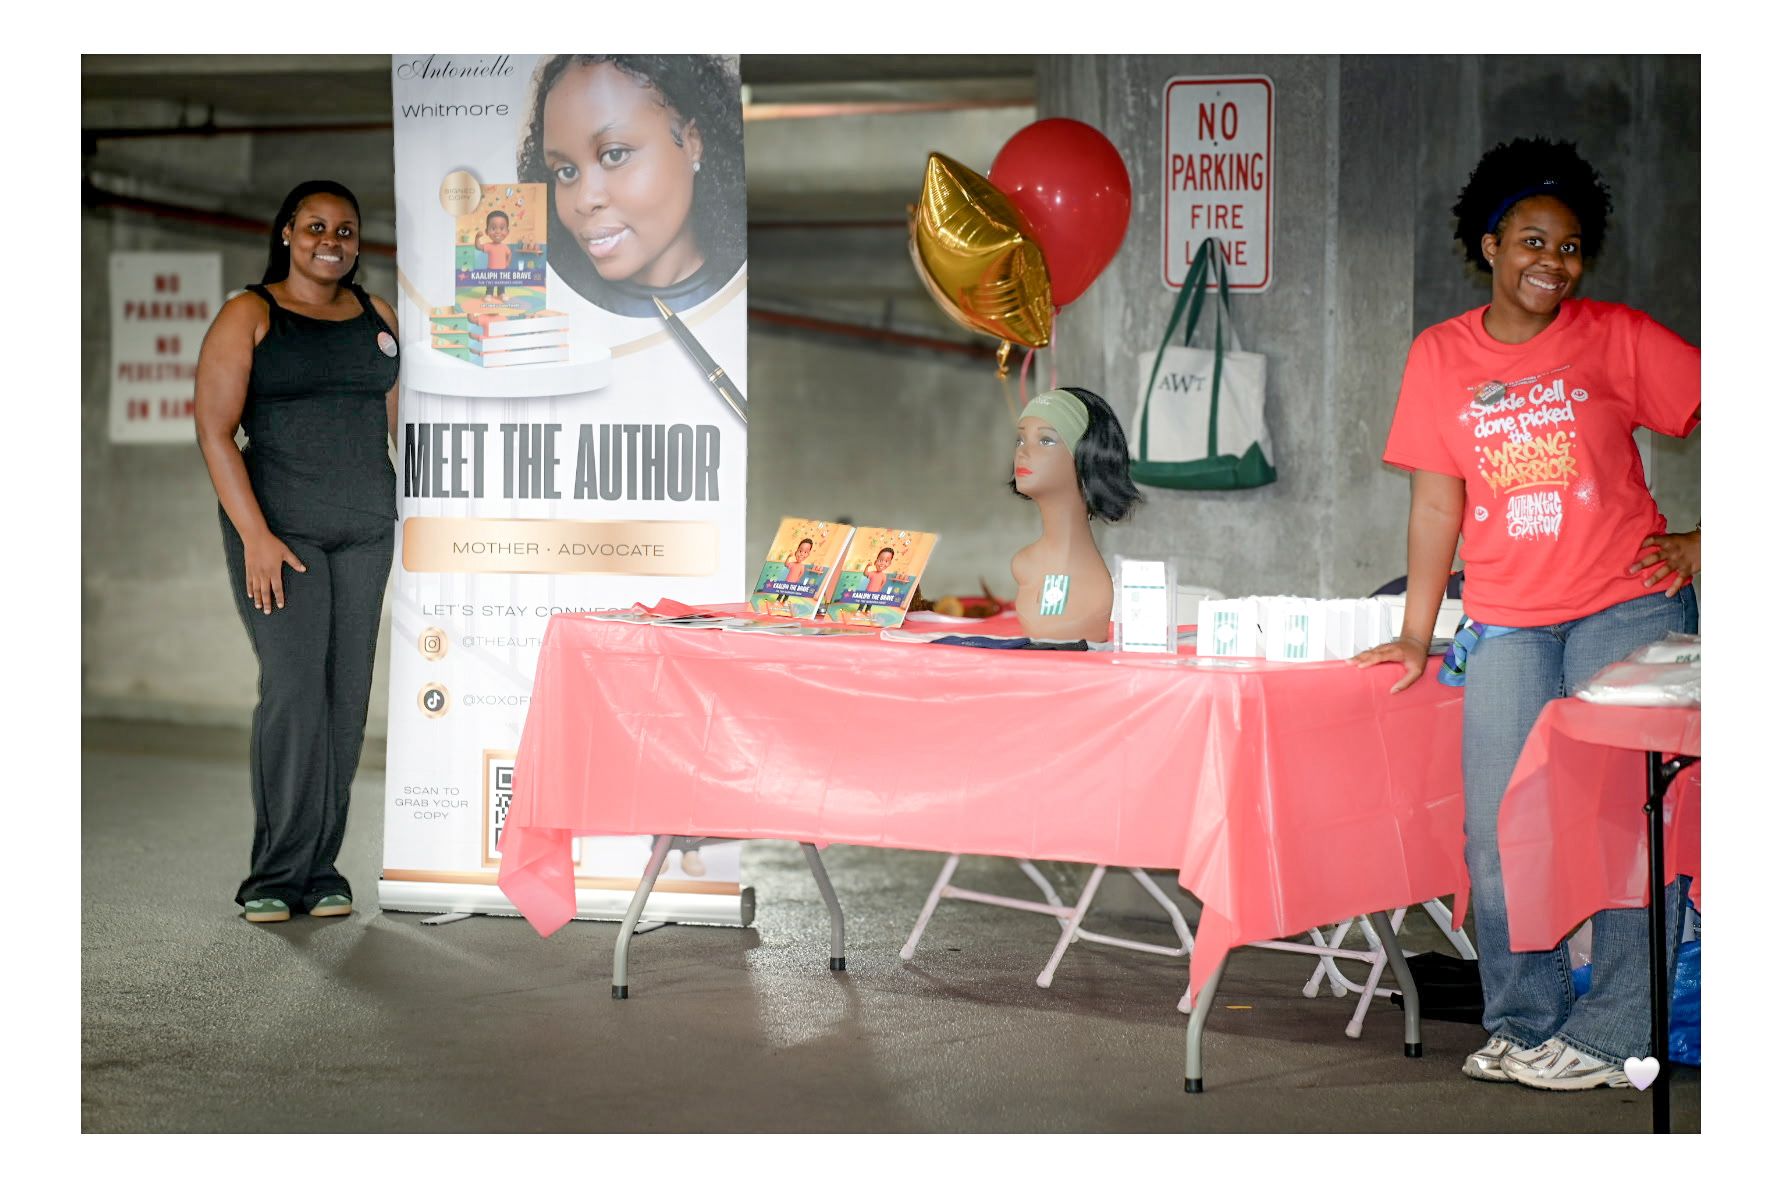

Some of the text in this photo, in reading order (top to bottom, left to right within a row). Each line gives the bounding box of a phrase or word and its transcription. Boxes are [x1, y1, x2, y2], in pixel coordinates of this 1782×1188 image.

[397, 54, 513, 80] Antonielle
[401, 104, 509, 118] Whitmore
[1198, 102, 1238, 141] NO
[1172, 153, 1264, 192] PARKING
[1191, 205, 1244, 229] FIRE
[1186, 241, 1247, 265] LNE
[155, 274, 181, 293] NO
[471, 272, 498, 280] KAALIPH
[500, 272, 511, 280] THE
[512, 272, 532, 280] BRAVE
[156, 336, 181, 354] NO
[1159, 373, 1206, 394] AWT
[1528, 379, 1566, 406] Cell
[1474, 400, 1575, 438] done picked
[1507, 428, 1533, 445] the
[1483, 431, 1572, 468] WRONG
[404, 423, 721, 502] MEET THE AUTHOR
[452, 542, 665, 557] MOTHER ADVOCATE
[422, 604, 474, 617] LET'S
[481, 605, 529, 618] STAY
[403, 786, 460, 796] SCAN TO
[395, 798, 469, 808] GRAB YOUR
[413, 811, 449, 820] COPY
